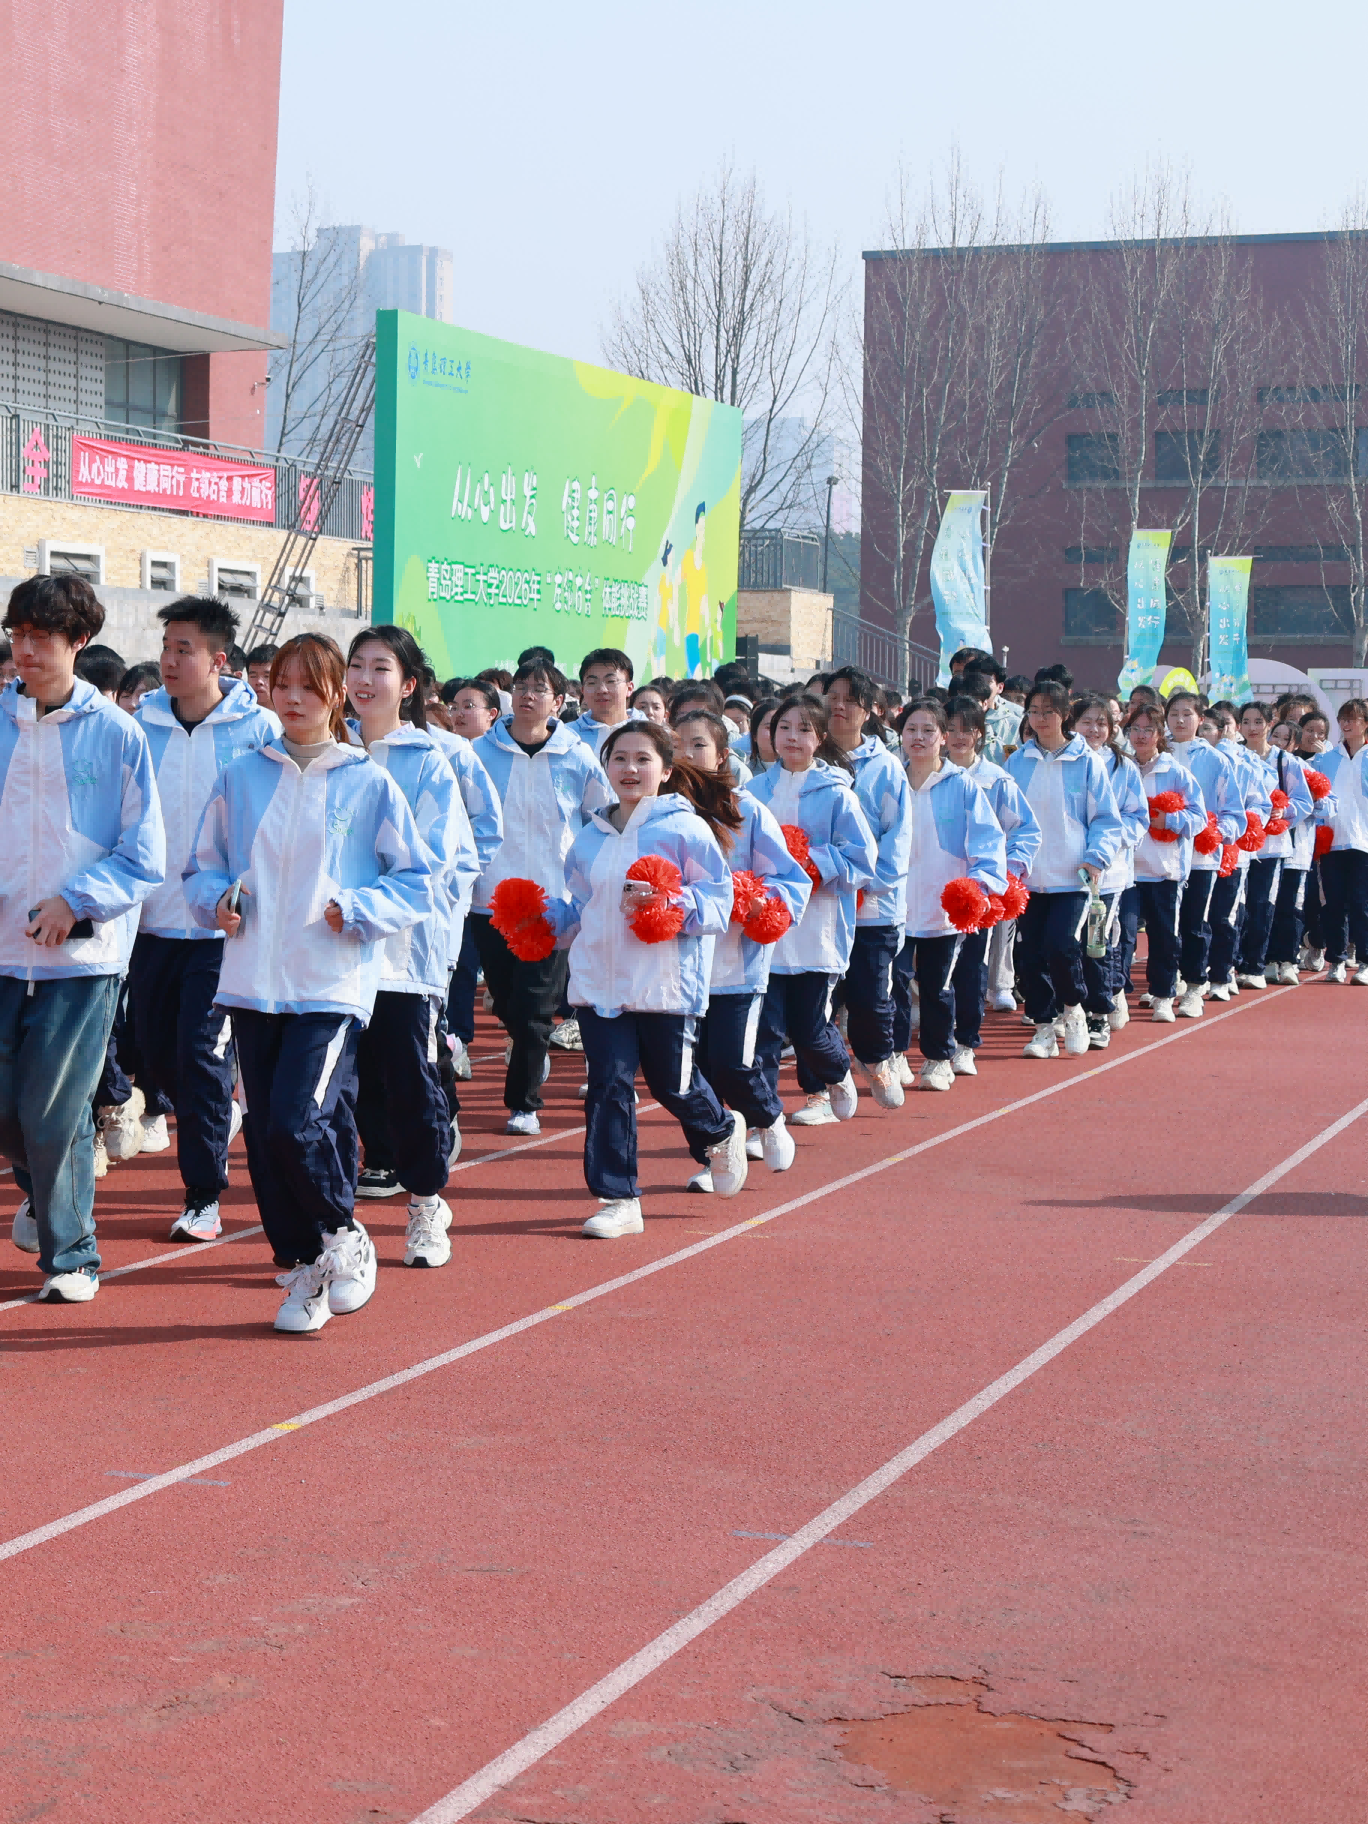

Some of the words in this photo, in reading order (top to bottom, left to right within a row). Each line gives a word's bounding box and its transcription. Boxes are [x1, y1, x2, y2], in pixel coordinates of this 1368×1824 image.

[78, 452, 129, 489] 从心出发
[133, 459, 186, 497] 健康同行
[451, 463, 537, 538] 从心出发
[562, 476, 636, 554] 健康同行
